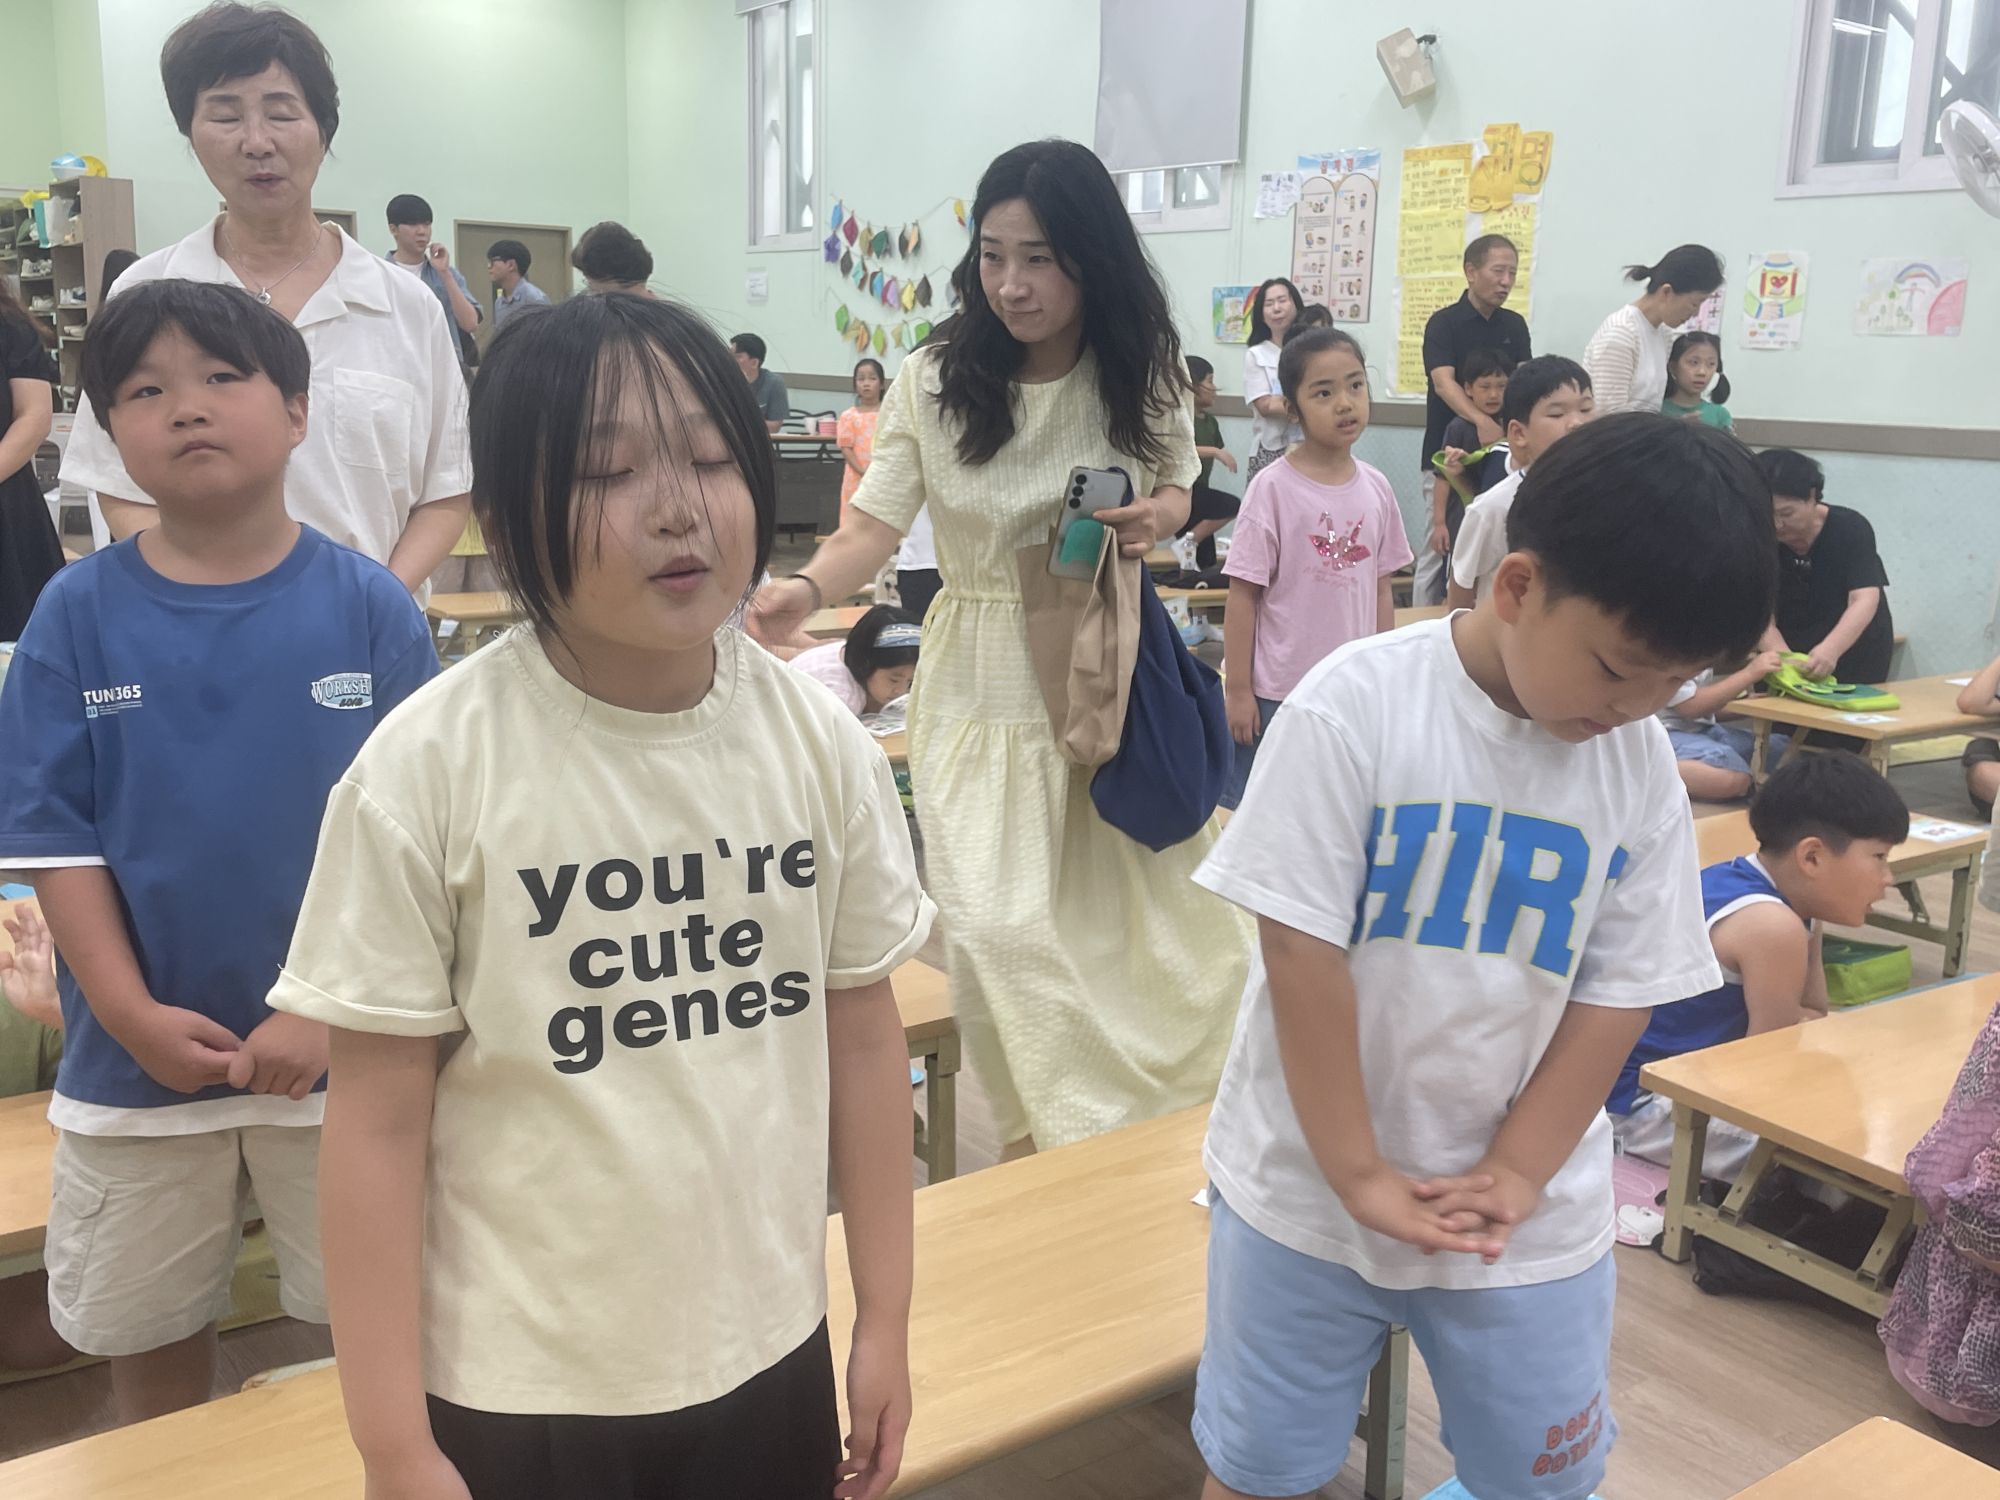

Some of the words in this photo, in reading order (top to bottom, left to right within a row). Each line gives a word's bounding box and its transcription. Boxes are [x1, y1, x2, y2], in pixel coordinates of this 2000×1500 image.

[311, 678, 372, 704] WORKSH
[1350, 801, 1628, 979] HIR
[568, 913, 764, 989] cute
[547, 971, 811, 1075] genes
